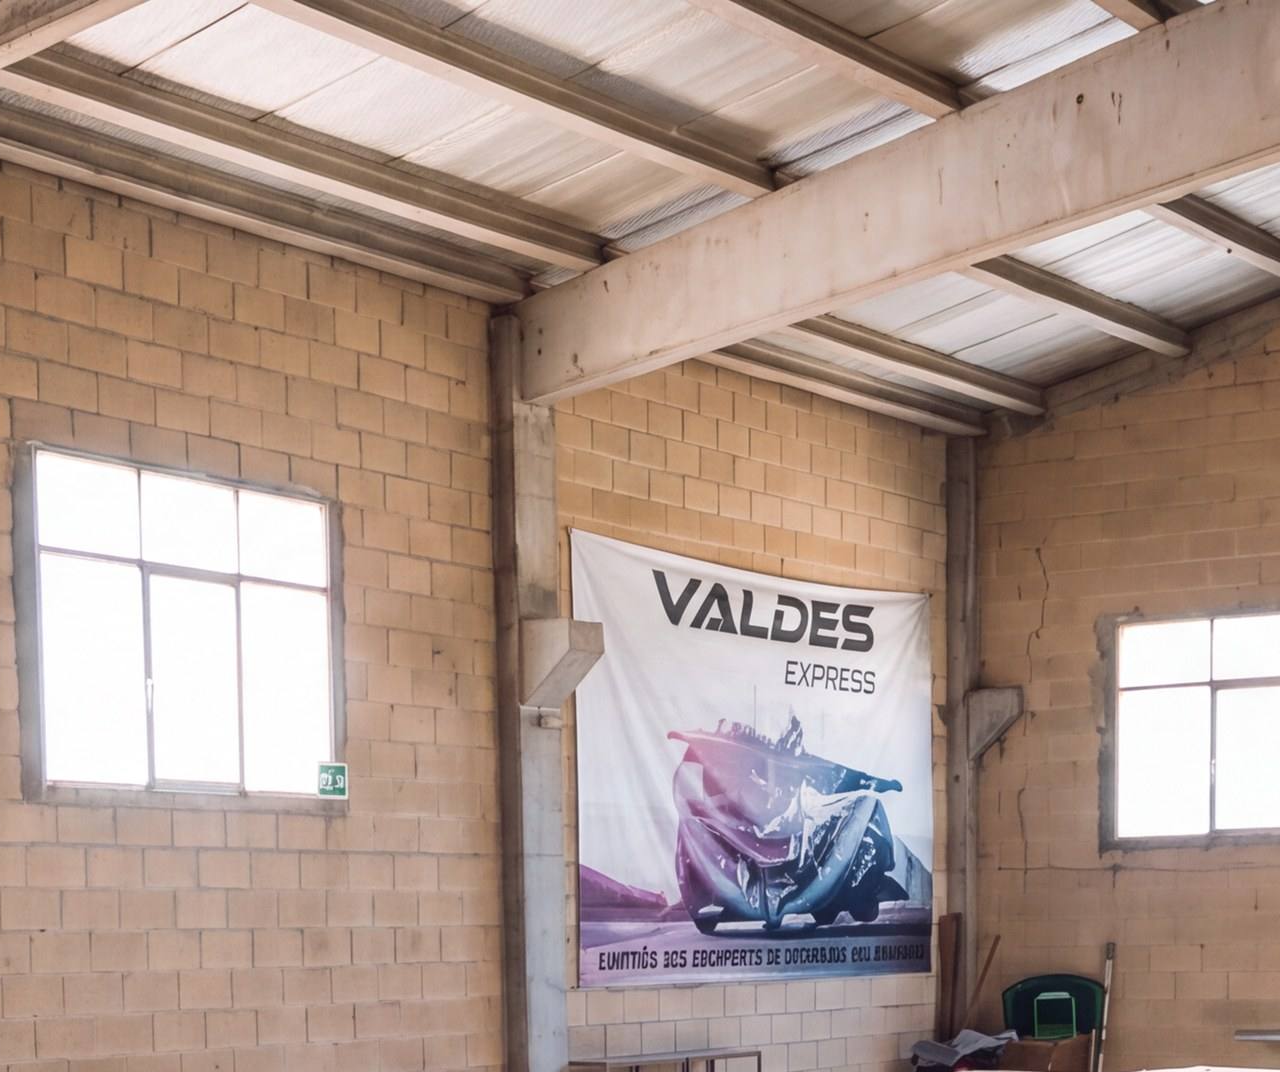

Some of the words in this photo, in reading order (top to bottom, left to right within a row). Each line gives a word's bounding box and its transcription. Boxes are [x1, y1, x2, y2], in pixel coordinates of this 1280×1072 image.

[652, 569, 875, 653] VALDES
[784, 660, 876, 695] EXPRESS
[766, 947, 782, 966] DE
